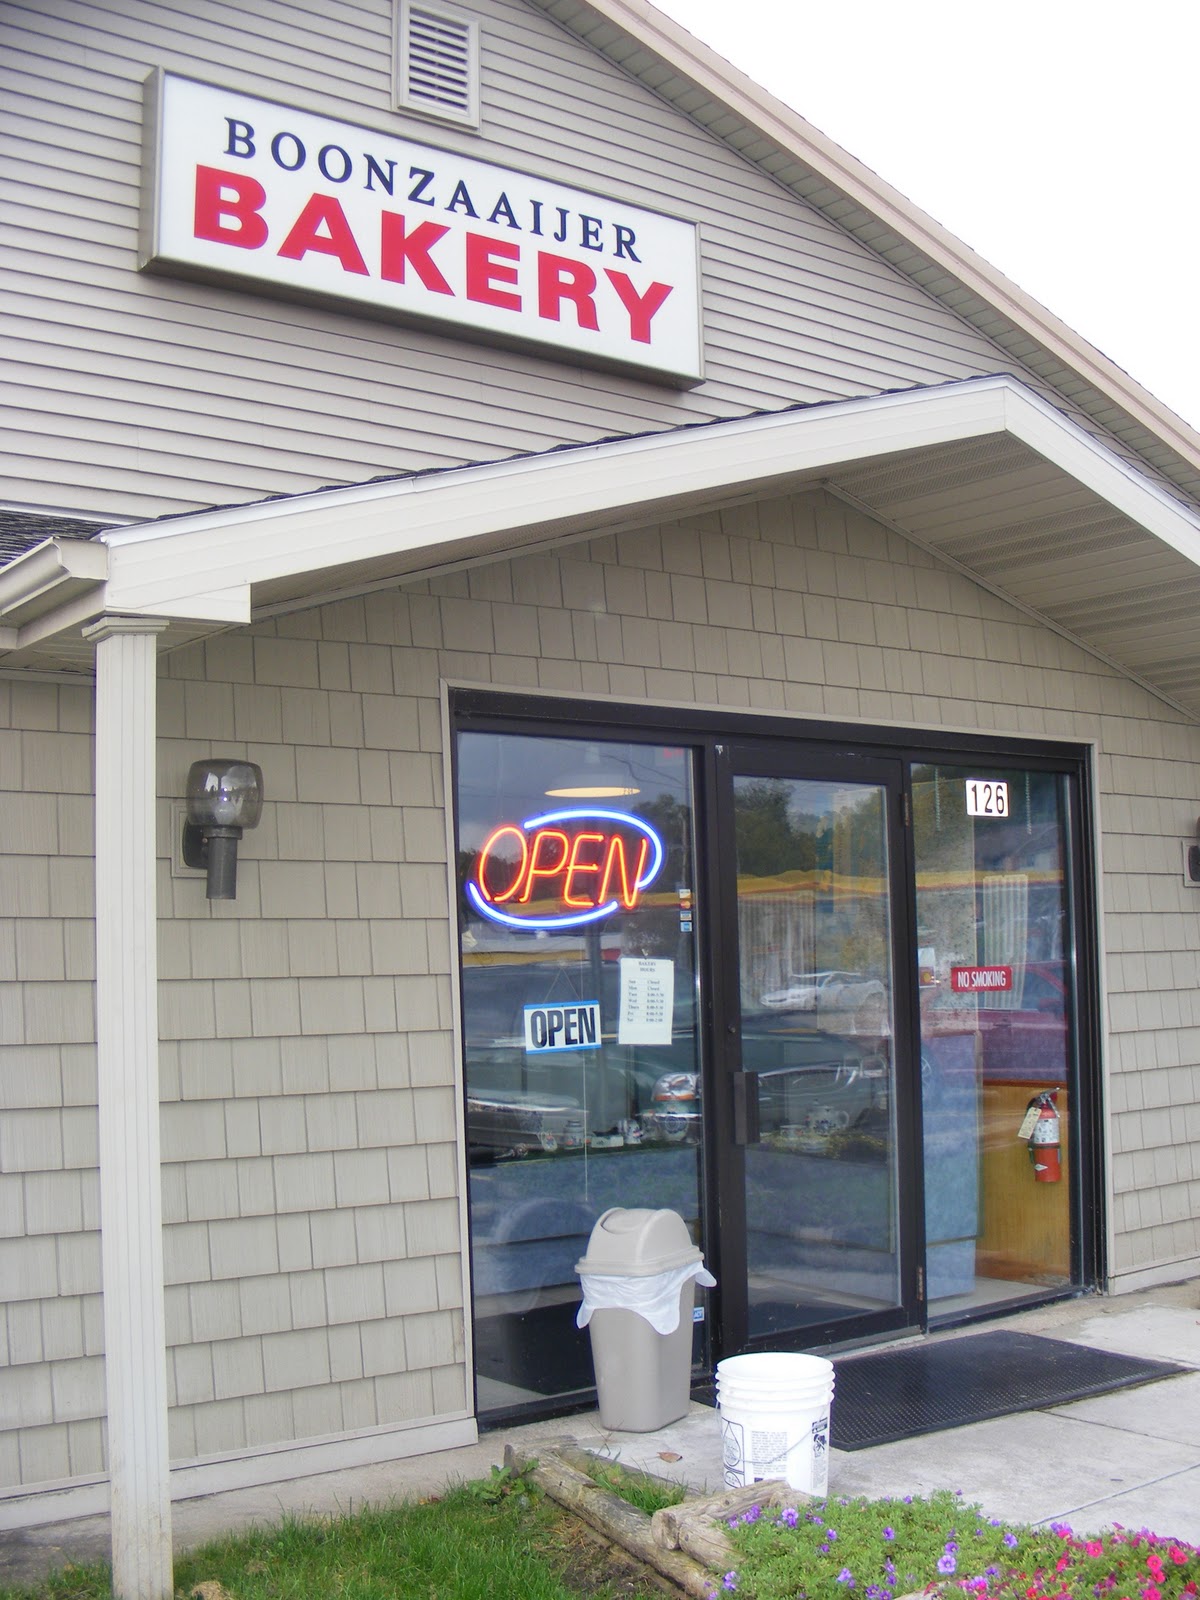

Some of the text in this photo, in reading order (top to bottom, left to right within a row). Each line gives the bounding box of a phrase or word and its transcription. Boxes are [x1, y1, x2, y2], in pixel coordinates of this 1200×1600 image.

[223, 117, 642, 263] BOONZAAIJER
[193, 163, 674, 345] BAKERY
[971, 783, 1005, 815] 126
[478, 823, 648, 910] OPEN
[957, 970, 1007, 988] NO SMOKING
[530, 1007, 596, 1049] OPEN
